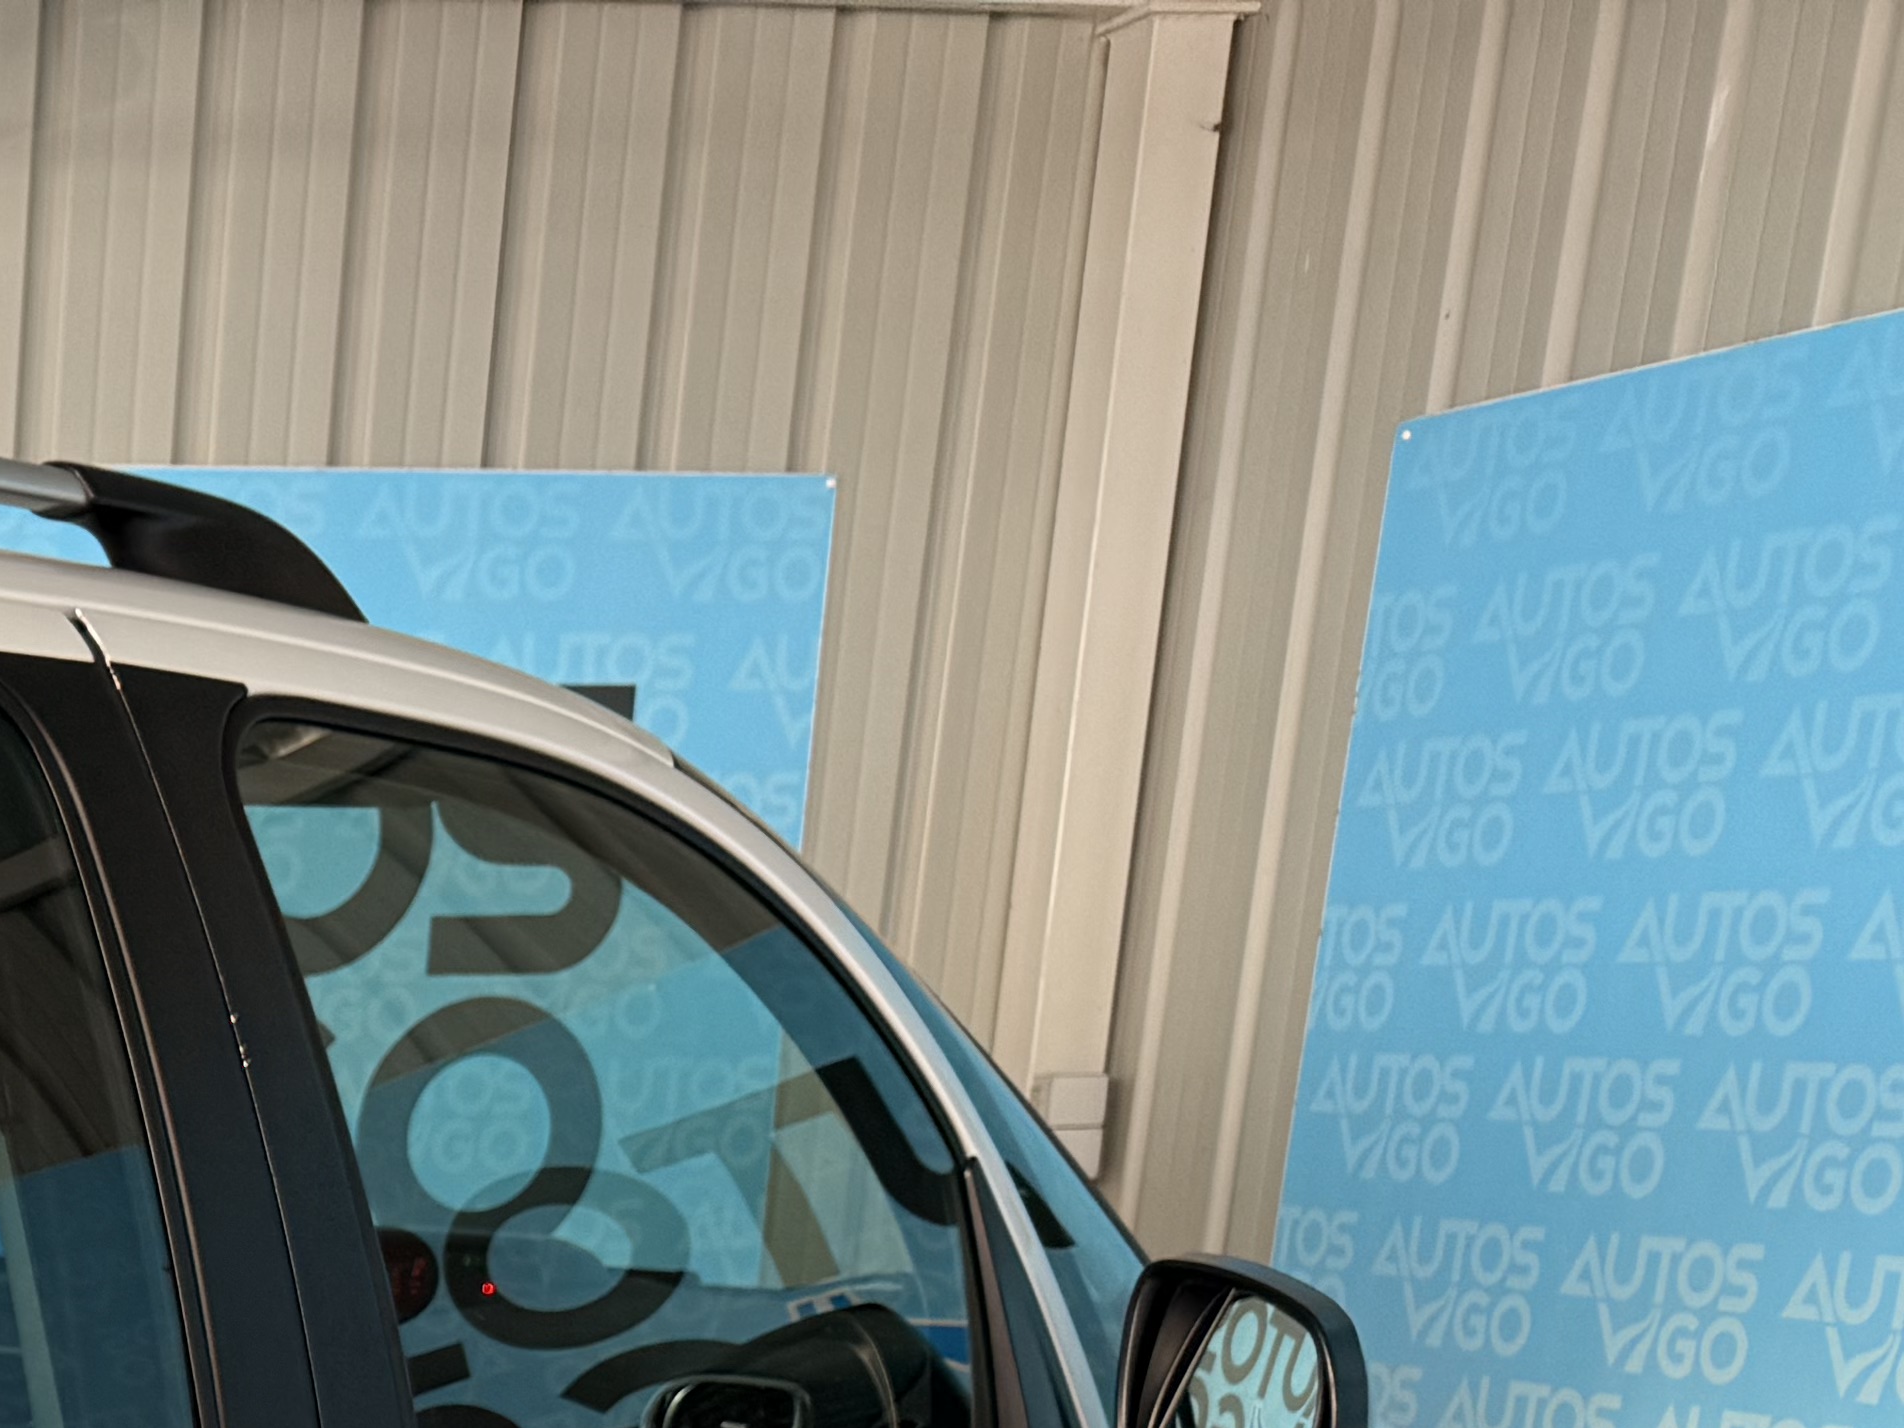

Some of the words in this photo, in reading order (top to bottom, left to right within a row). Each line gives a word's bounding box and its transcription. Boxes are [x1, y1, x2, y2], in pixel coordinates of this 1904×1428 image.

[1599, 345, 1806, 453] AUTOS
[1405, 401, 1579, 491] AUTOS
[1638, 426, 1792, 514] VIGO
[353, 482, 581, 541] AUTOS
[605, 483, 827, 542] AUTOS
[1438, 467, 1567, 549] VIGO
[402, 543, 577, 601] VIGO
[656, 543, 822, 601] VIGO
[1473, 551, 1663, 645] AUTOS
[1677, 511, 1902, 618] AUTOS
[1505, 628, 1644, 705] VIGO
[1718, 599, 1880, 684] VIGO
[1355, 728, 1529, 809] AUTOS
[1543, 708, 1743, 796] AUTOS
[1758, 694, 1904, 780] AUT
[1388, 801, 1515, 871] VIGO
[1577, 785, 1726, 861] VIGO
[1420, 896, 1604, 967] AUTOS
[1616, 886, 1832, 964] AUTOS
[1453, 966, 1588, 1035] VIGO
[1655, 962, 1813, 1039] VIGO
[1309, 1052, 1475, 1120] AUTOS
[1487, 1056, 1682, 1129] AUTOS
[1339, 1117, 1461, 1185] VIGO
[1521, 1124, 1665, 1199] VIGO
[1736, 1132, 1903, 1216] VIGO
[1372, 1214, 1545, 1291] AUTOS
[1559, 1231, 1766, 1315] AUTOS
[1402, 1279, 1532, 1358] VIGO
[1597, 1302, 1749, 1385] VIGO
